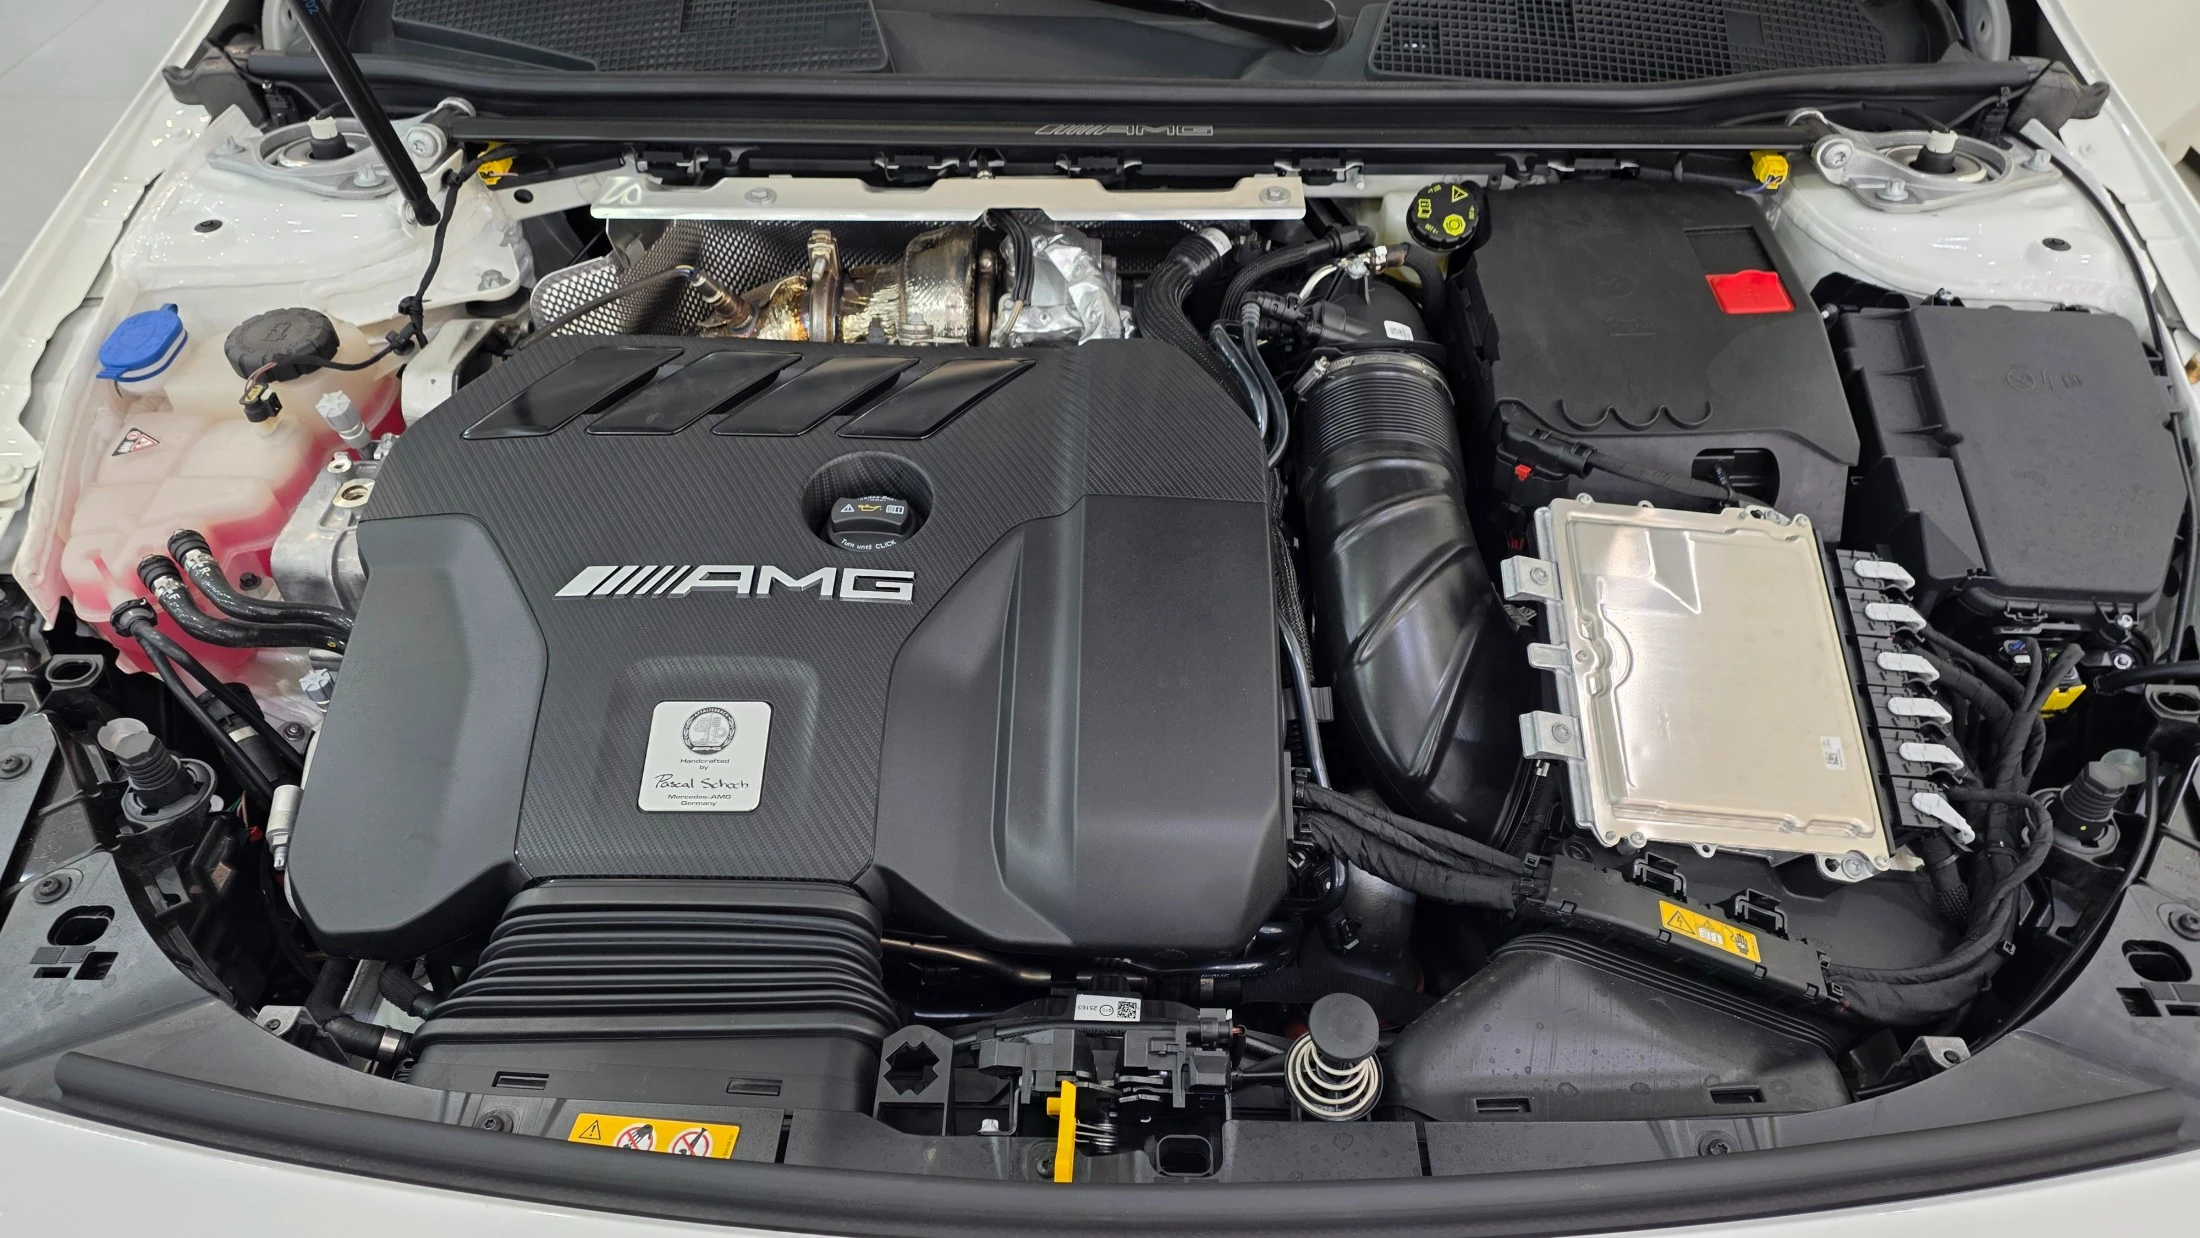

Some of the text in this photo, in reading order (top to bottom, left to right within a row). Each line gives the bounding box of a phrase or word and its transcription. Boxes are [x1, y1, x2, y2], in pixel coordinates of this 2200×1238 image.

[1094, 124, 1214, 136] AMG
[841, 538, 855, 548] Turn
[875, 539, 897, 549] CLICK
[668, 564, 917, 604] AMG
[654, 773, 694, 789] Pascal
